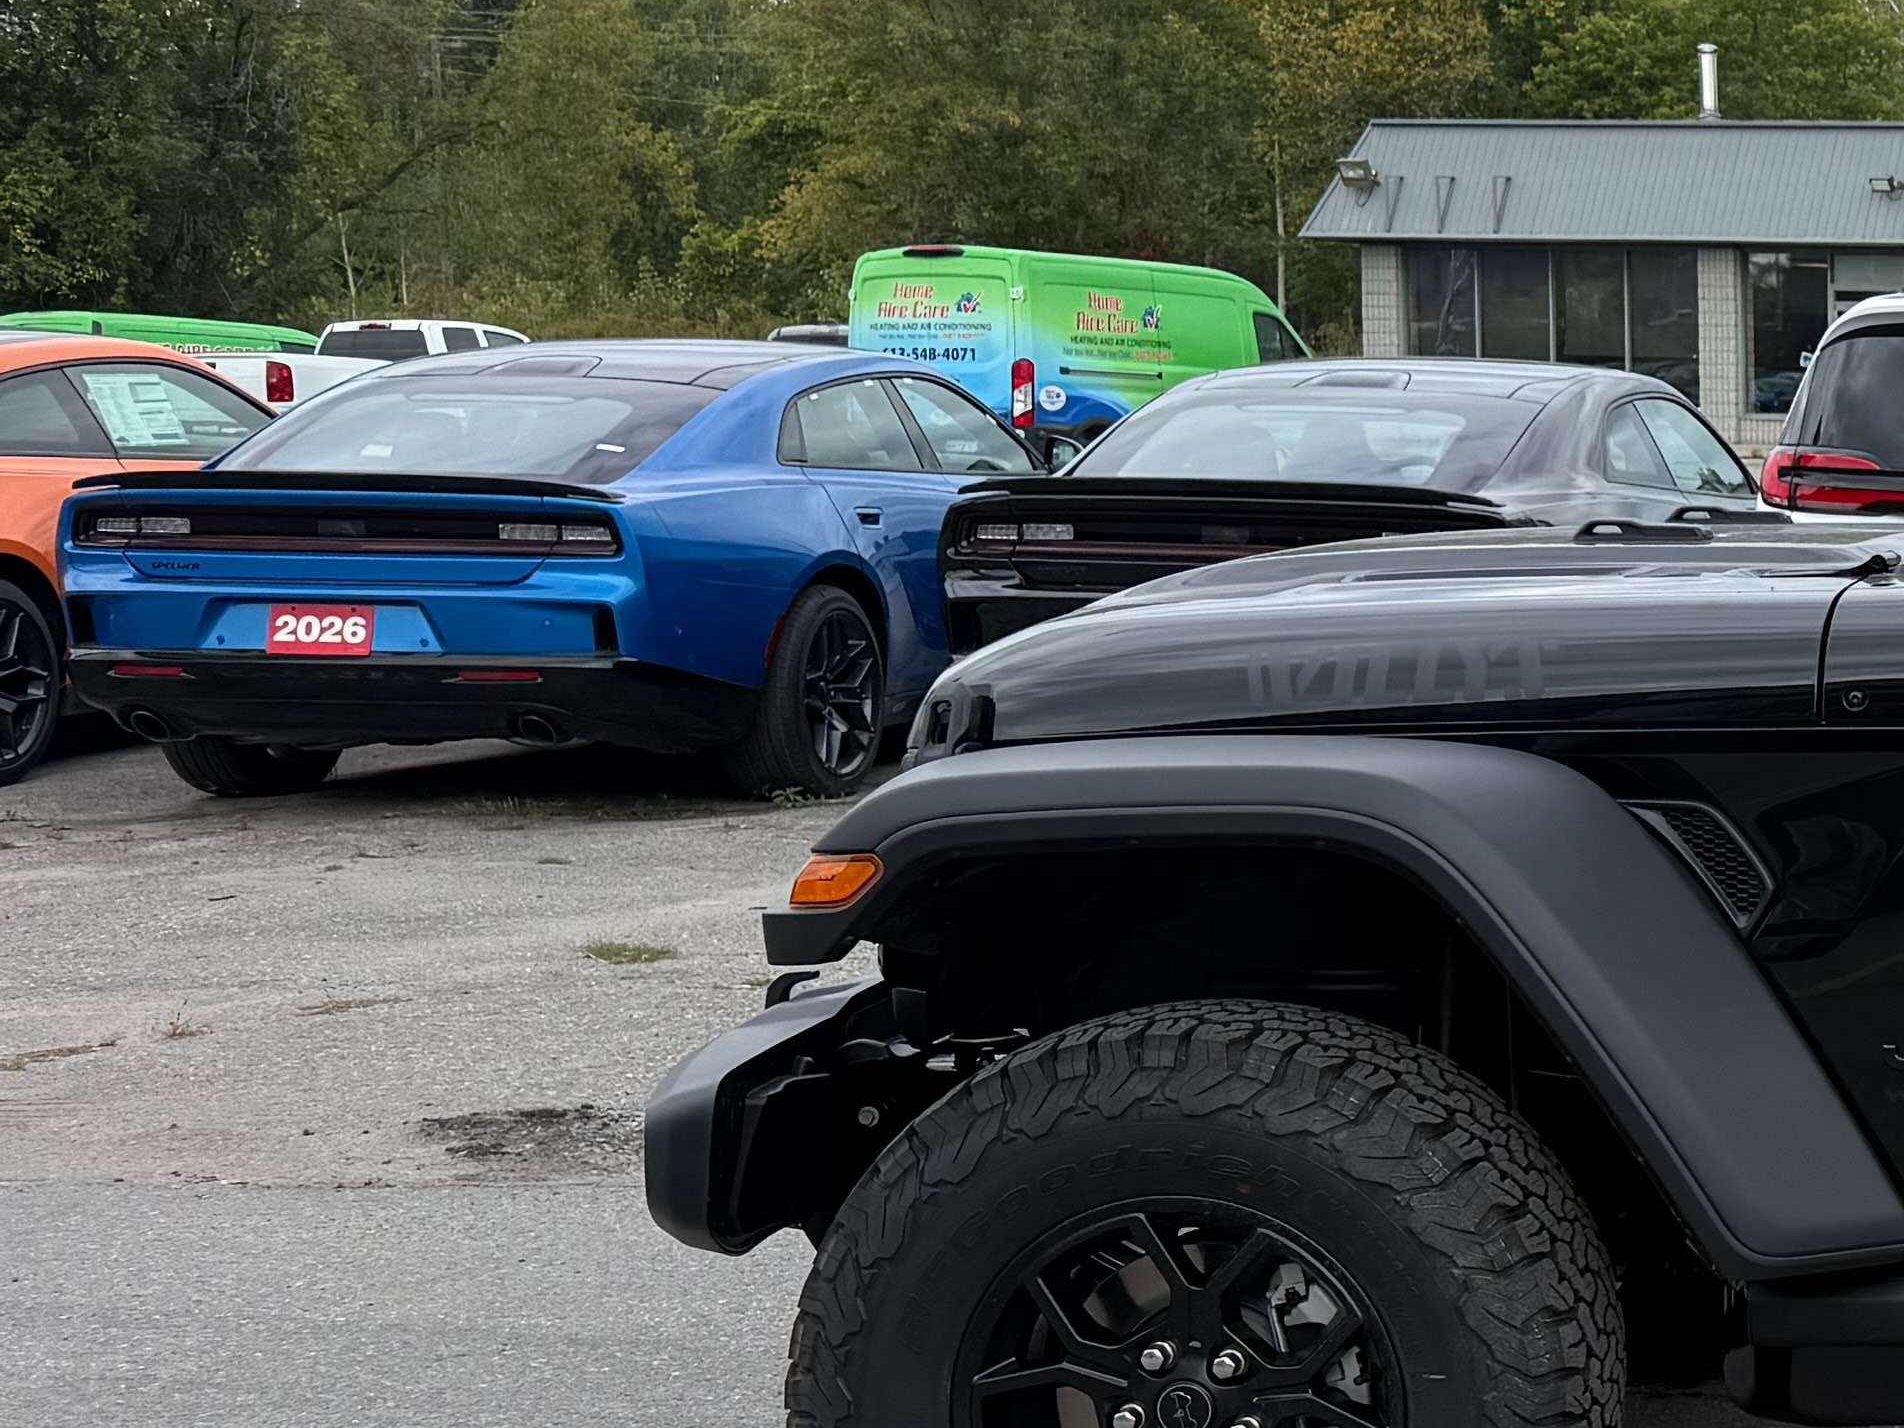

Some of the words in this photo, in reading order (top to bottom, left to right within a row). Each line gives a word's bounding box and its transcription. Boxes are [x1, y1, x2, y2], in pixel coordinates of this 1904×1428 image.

[893, 281, 934, 299] Home
[912, 301, 950, 319] Care
[902, 323, 918, 331] AND
[272, 614, 367, 644] 2026
